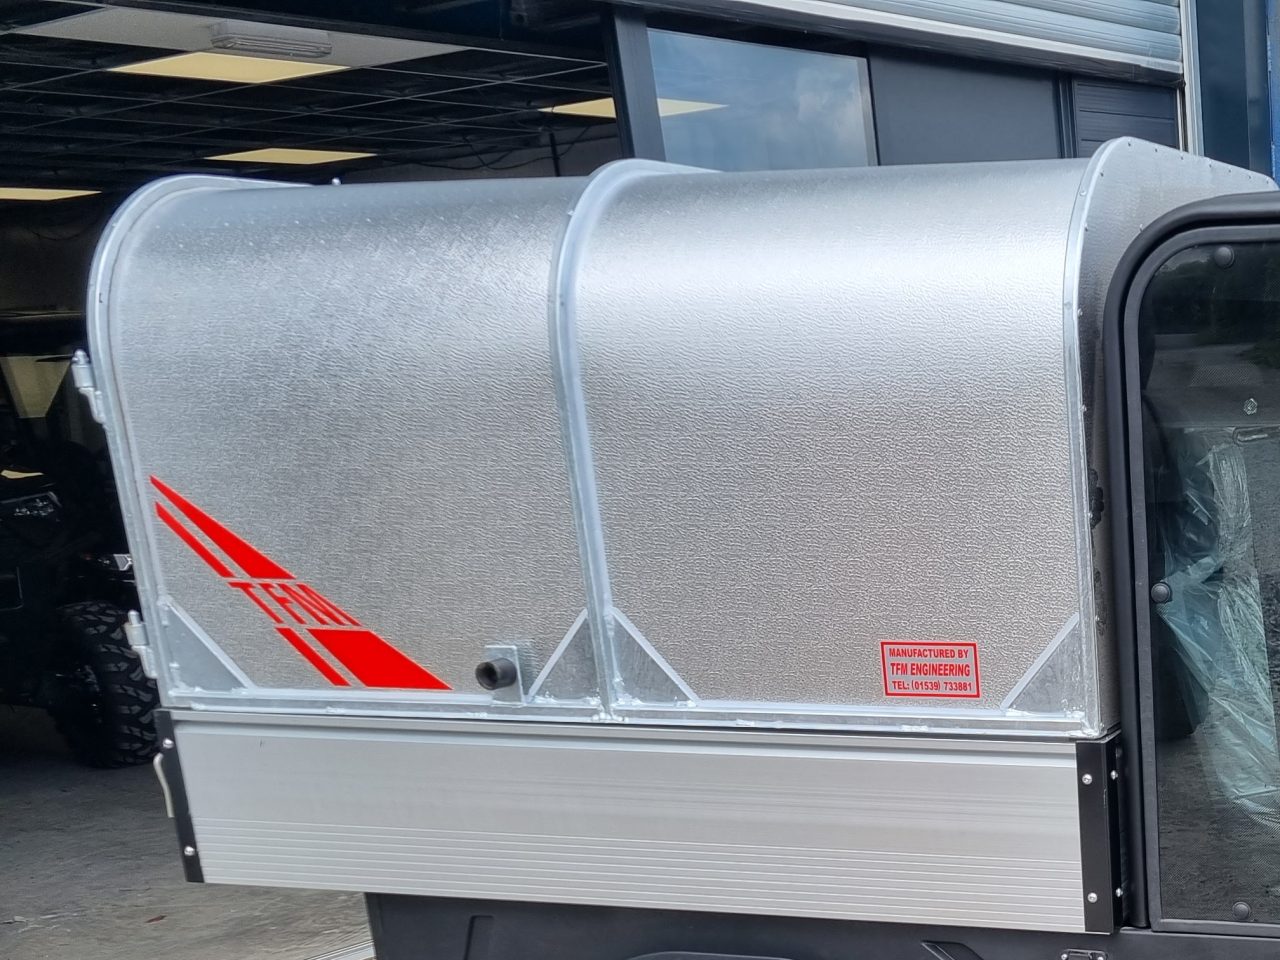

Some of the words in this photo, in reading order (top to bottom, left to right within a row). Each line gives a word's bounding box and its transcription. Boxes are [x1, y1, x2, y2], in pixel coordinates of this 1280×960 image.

[227, 581, 361, 626] TFM
[889, 648, 955, 658] MANUFACTURED
[958, 649, 969, 659] BY
[890, 662, 908, 675] TFM
[910, 663, 970, 677] ENGINEERING
[892, 680, 910, 690] TEL:
[911, 680, 941, 691] (01539)
[944, 682, 972, 691] 733881
